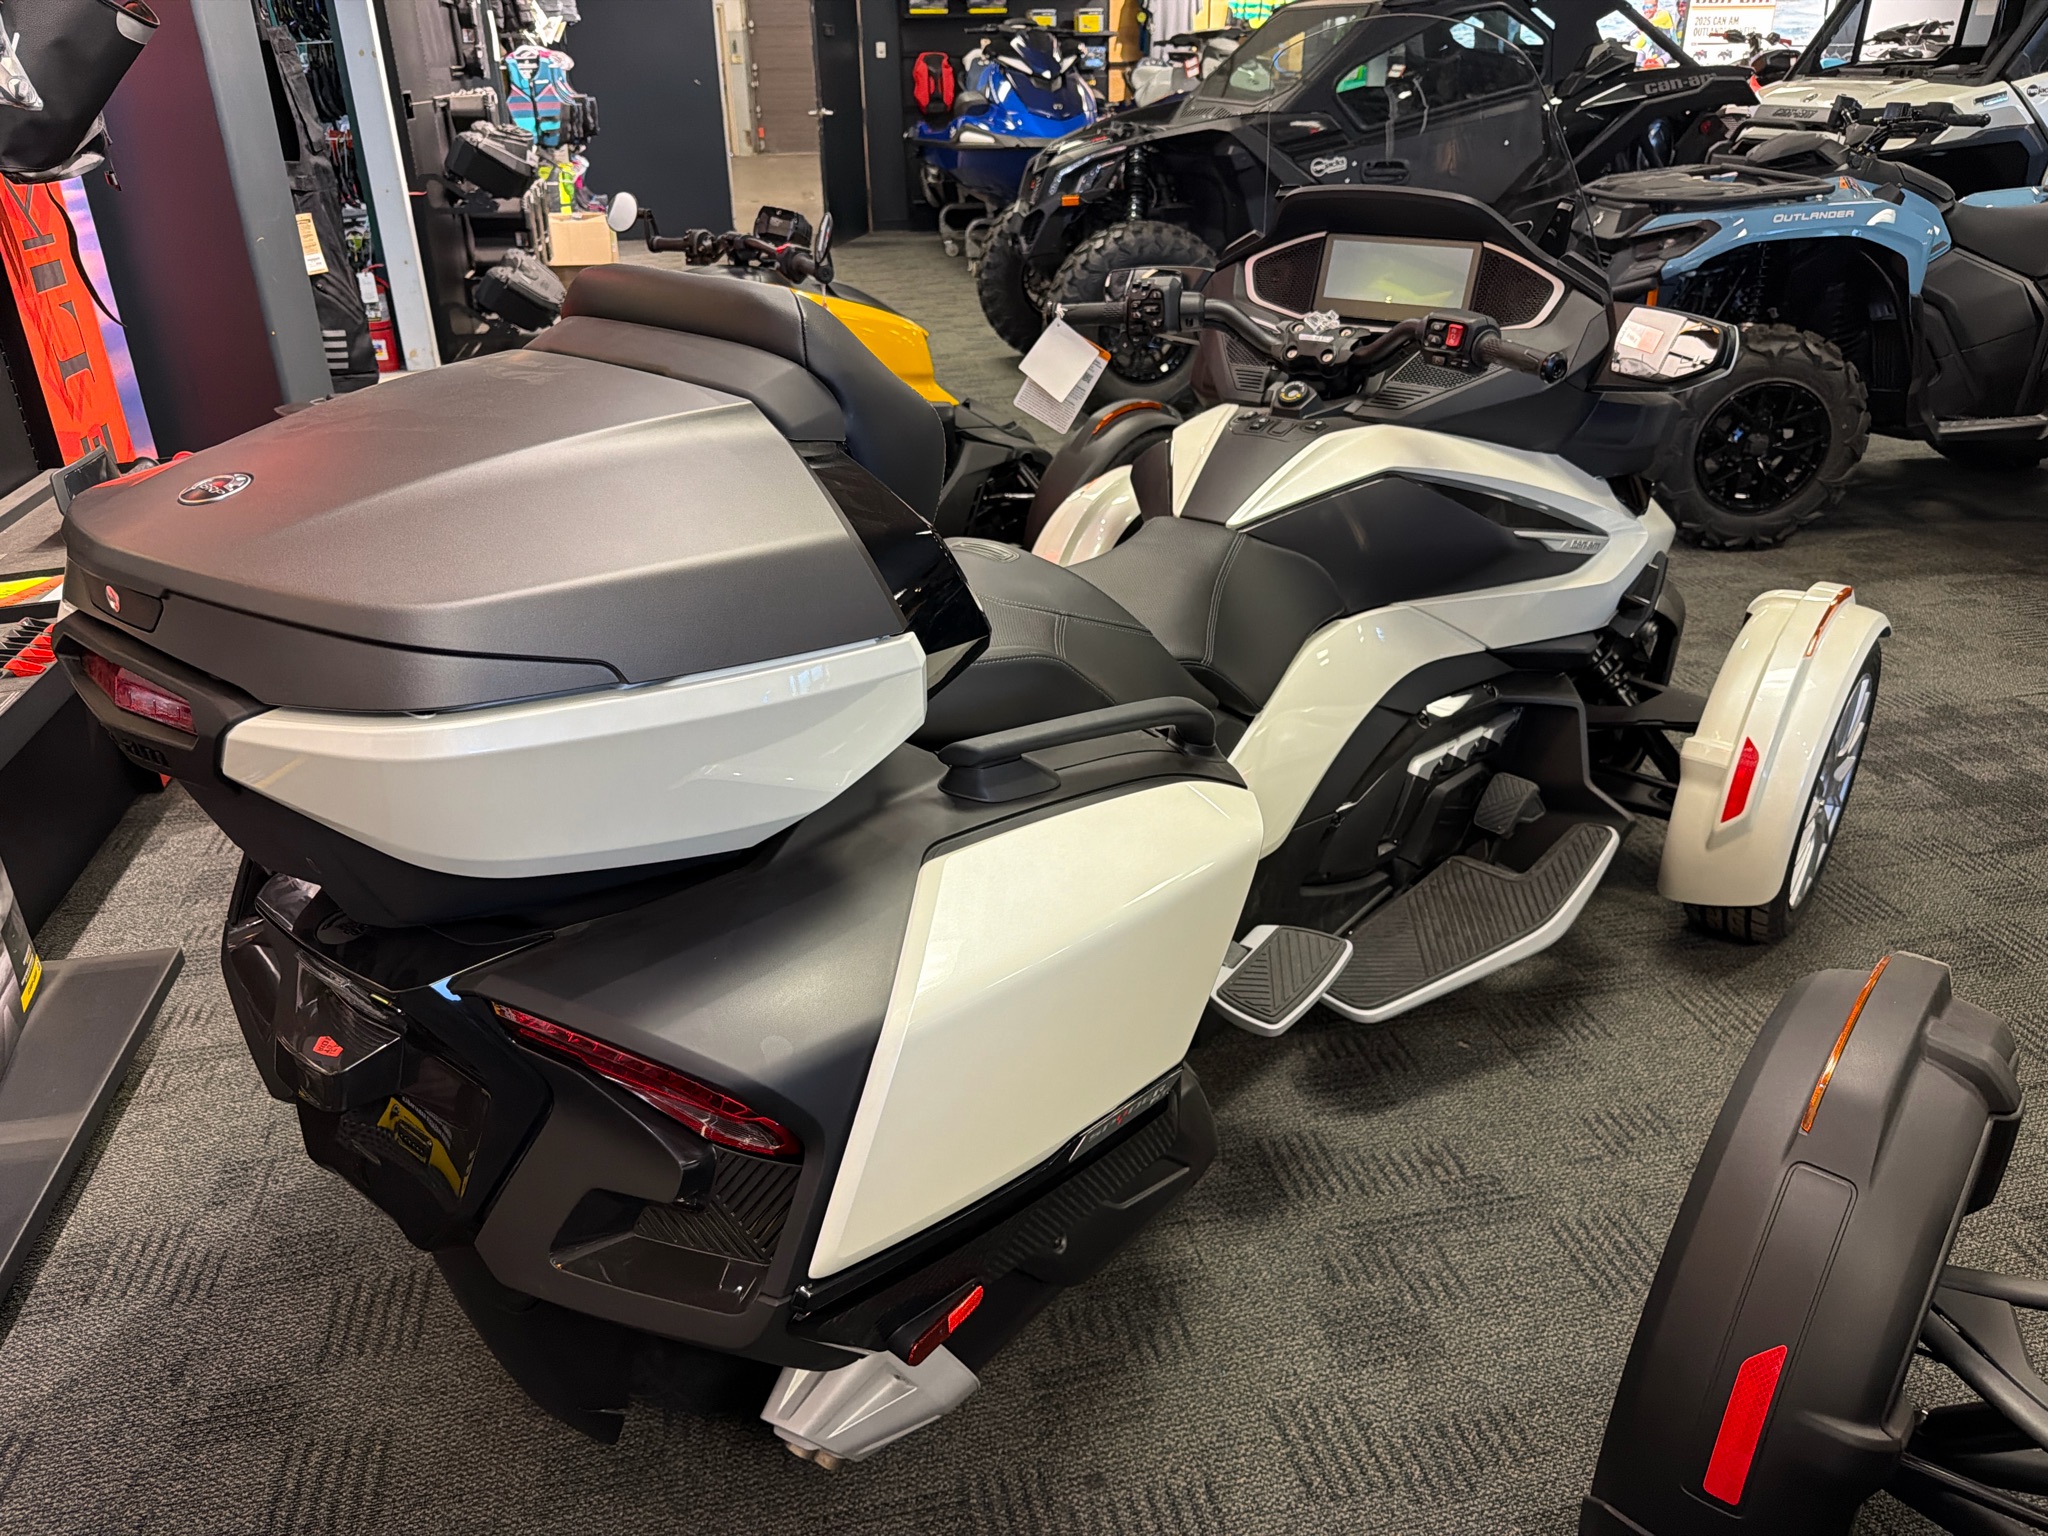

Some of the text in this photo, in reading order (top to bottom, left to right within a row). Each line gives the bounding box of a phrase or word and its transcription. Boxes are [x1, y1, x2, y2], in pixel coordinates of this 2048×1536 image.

[1695, 16, 1740, 26] 2025 CAN AM
[1773, 209, 1855, 223] OUTLANDER
